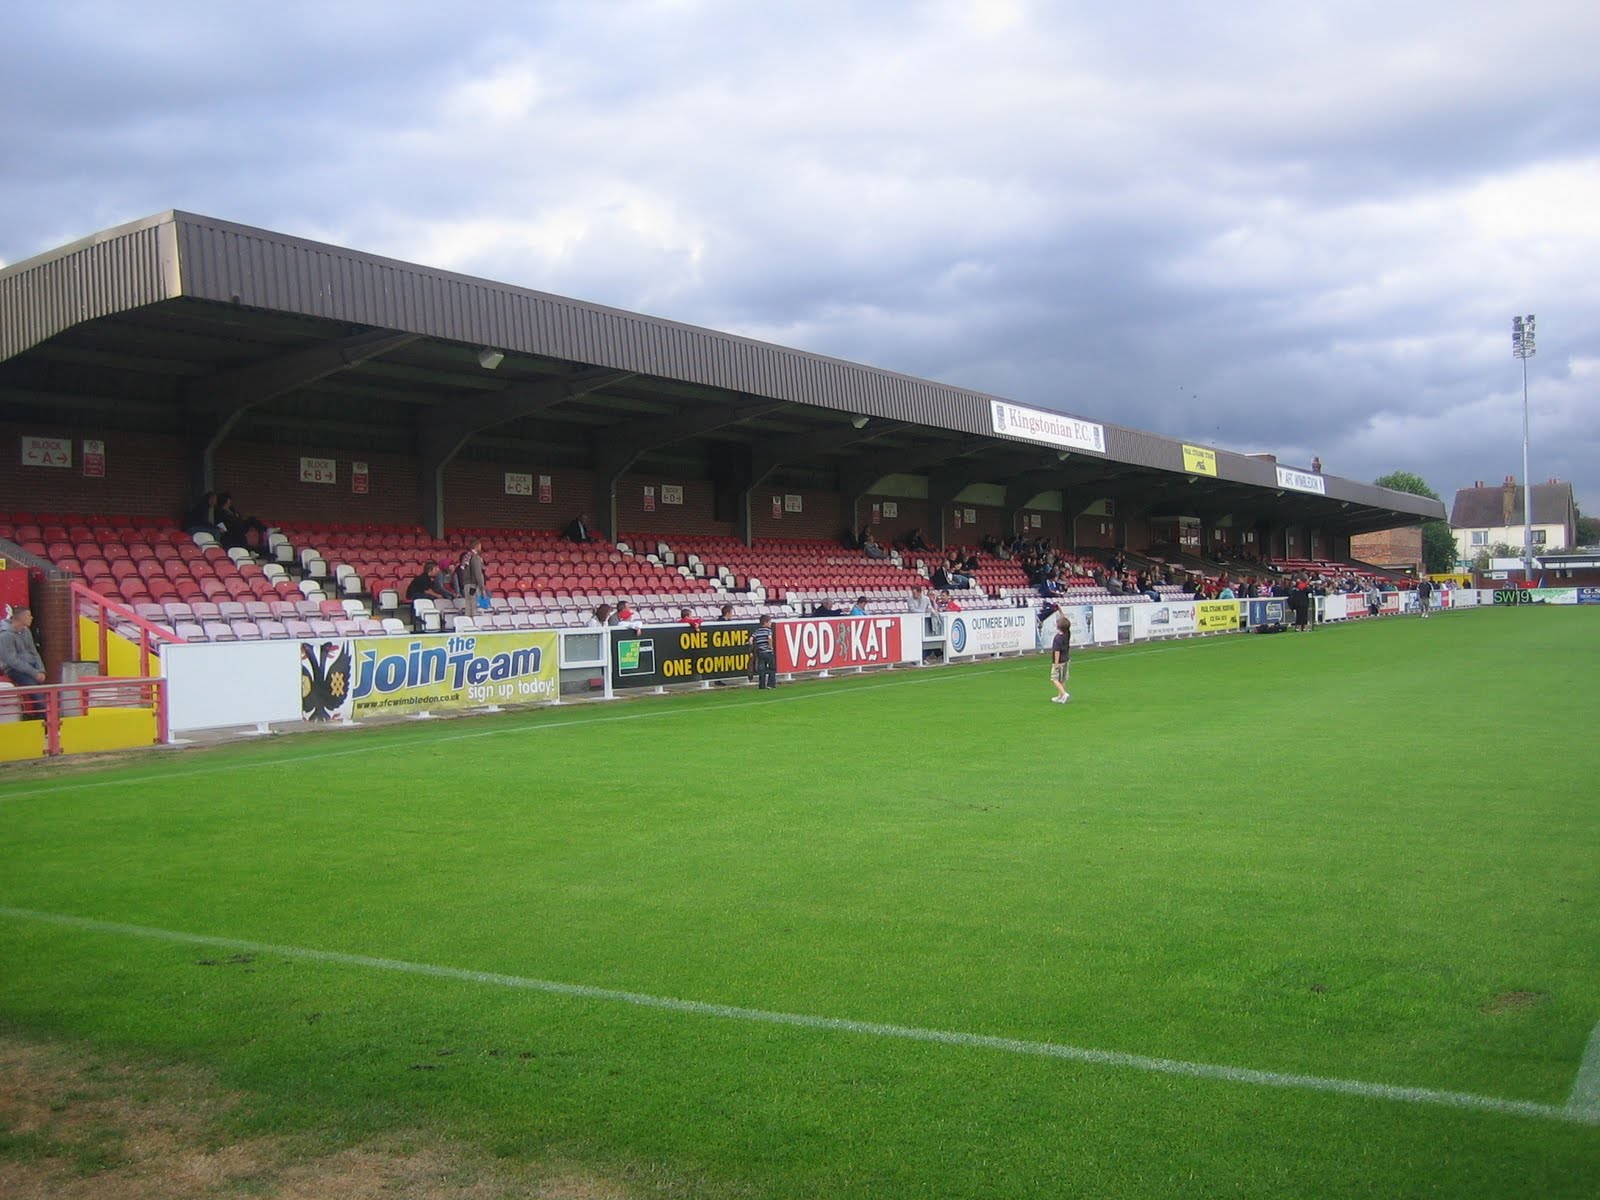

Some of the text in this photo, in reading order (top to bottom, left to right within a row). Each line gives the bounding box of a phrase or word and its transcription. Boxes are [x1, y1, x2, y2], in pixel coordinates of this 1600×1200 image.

[1008, 407, 1092, 442] Kingstonian F.C.
[31, 441, 61, 450] BLOCK
[42, 451, 53, 465] A
[307, 460, 329, 469] BLOCK
[314, 470, 322, 481] B
[515, 482, 522, 493] C
[1494, 590, 1529, 602] SW19
[972, 615, 1025, 630] OUTMERE DM LTD
[448, 637, 476, 653] the
[680, 632, 708, 650] ONE
[449, 646, 541, 690] Team
[663, 658, 692, 678] ONE
[468, 676, 555, 703] sign up today!
[357, 693, 461, 709] www.afcwimbledon.co.uk
